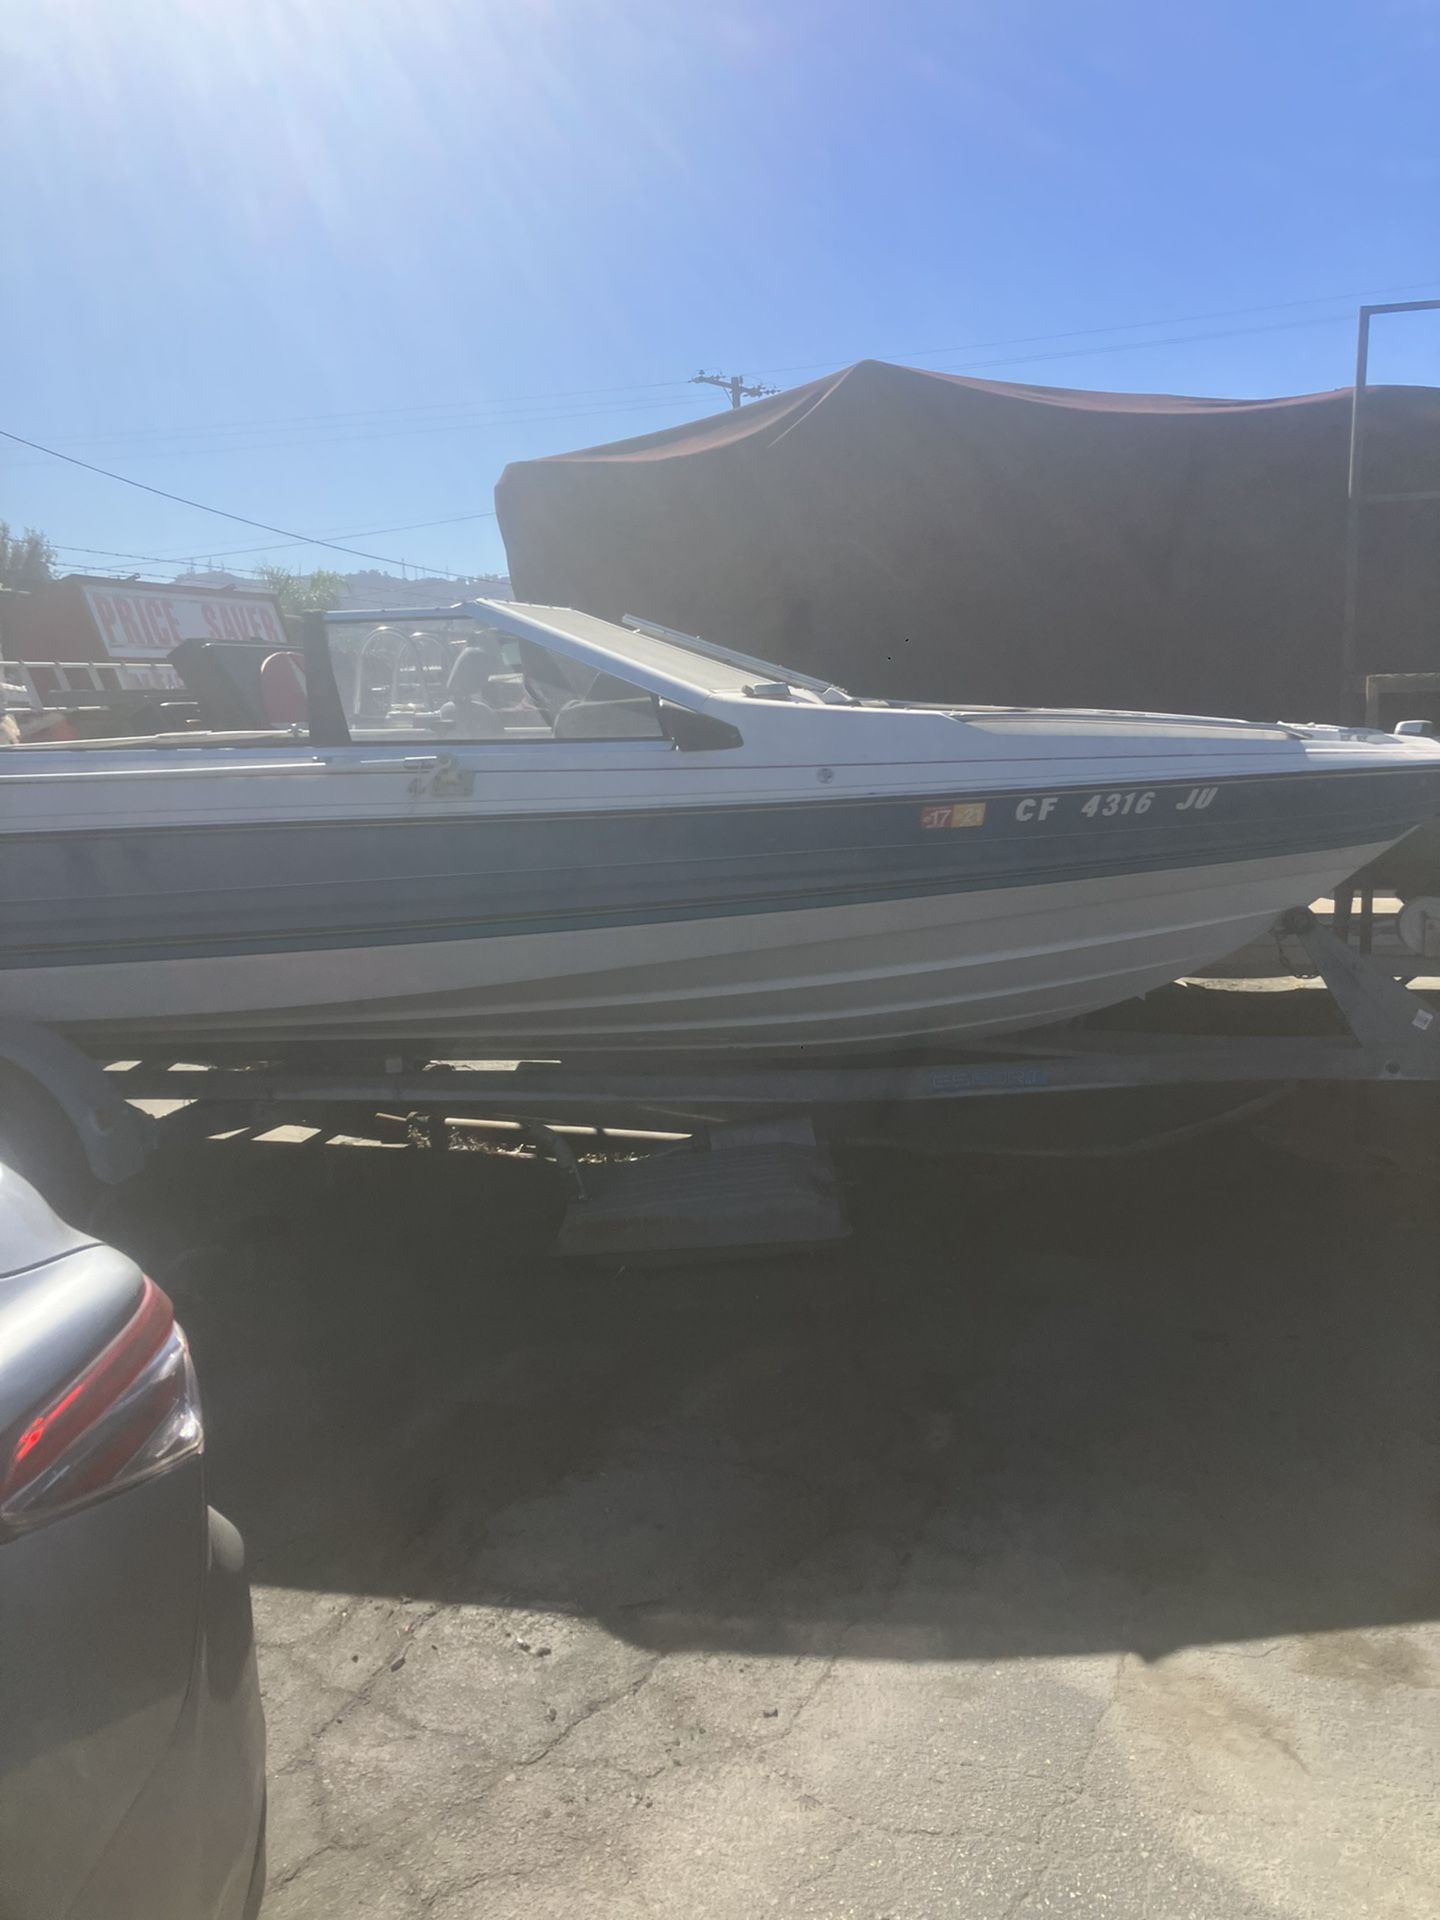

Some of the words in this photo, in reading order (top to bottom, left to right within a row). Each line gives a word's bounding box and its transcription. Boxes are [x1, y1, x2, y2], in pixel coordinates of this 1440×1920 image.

[95, 595, 183, 645] PRICE
[202, 603, 280, 642] SAVER
[1015, 798, 1058, 822] CF
[1080, 791, 1155, 818] 4316
[1175, 787, 1218, 810] JU
